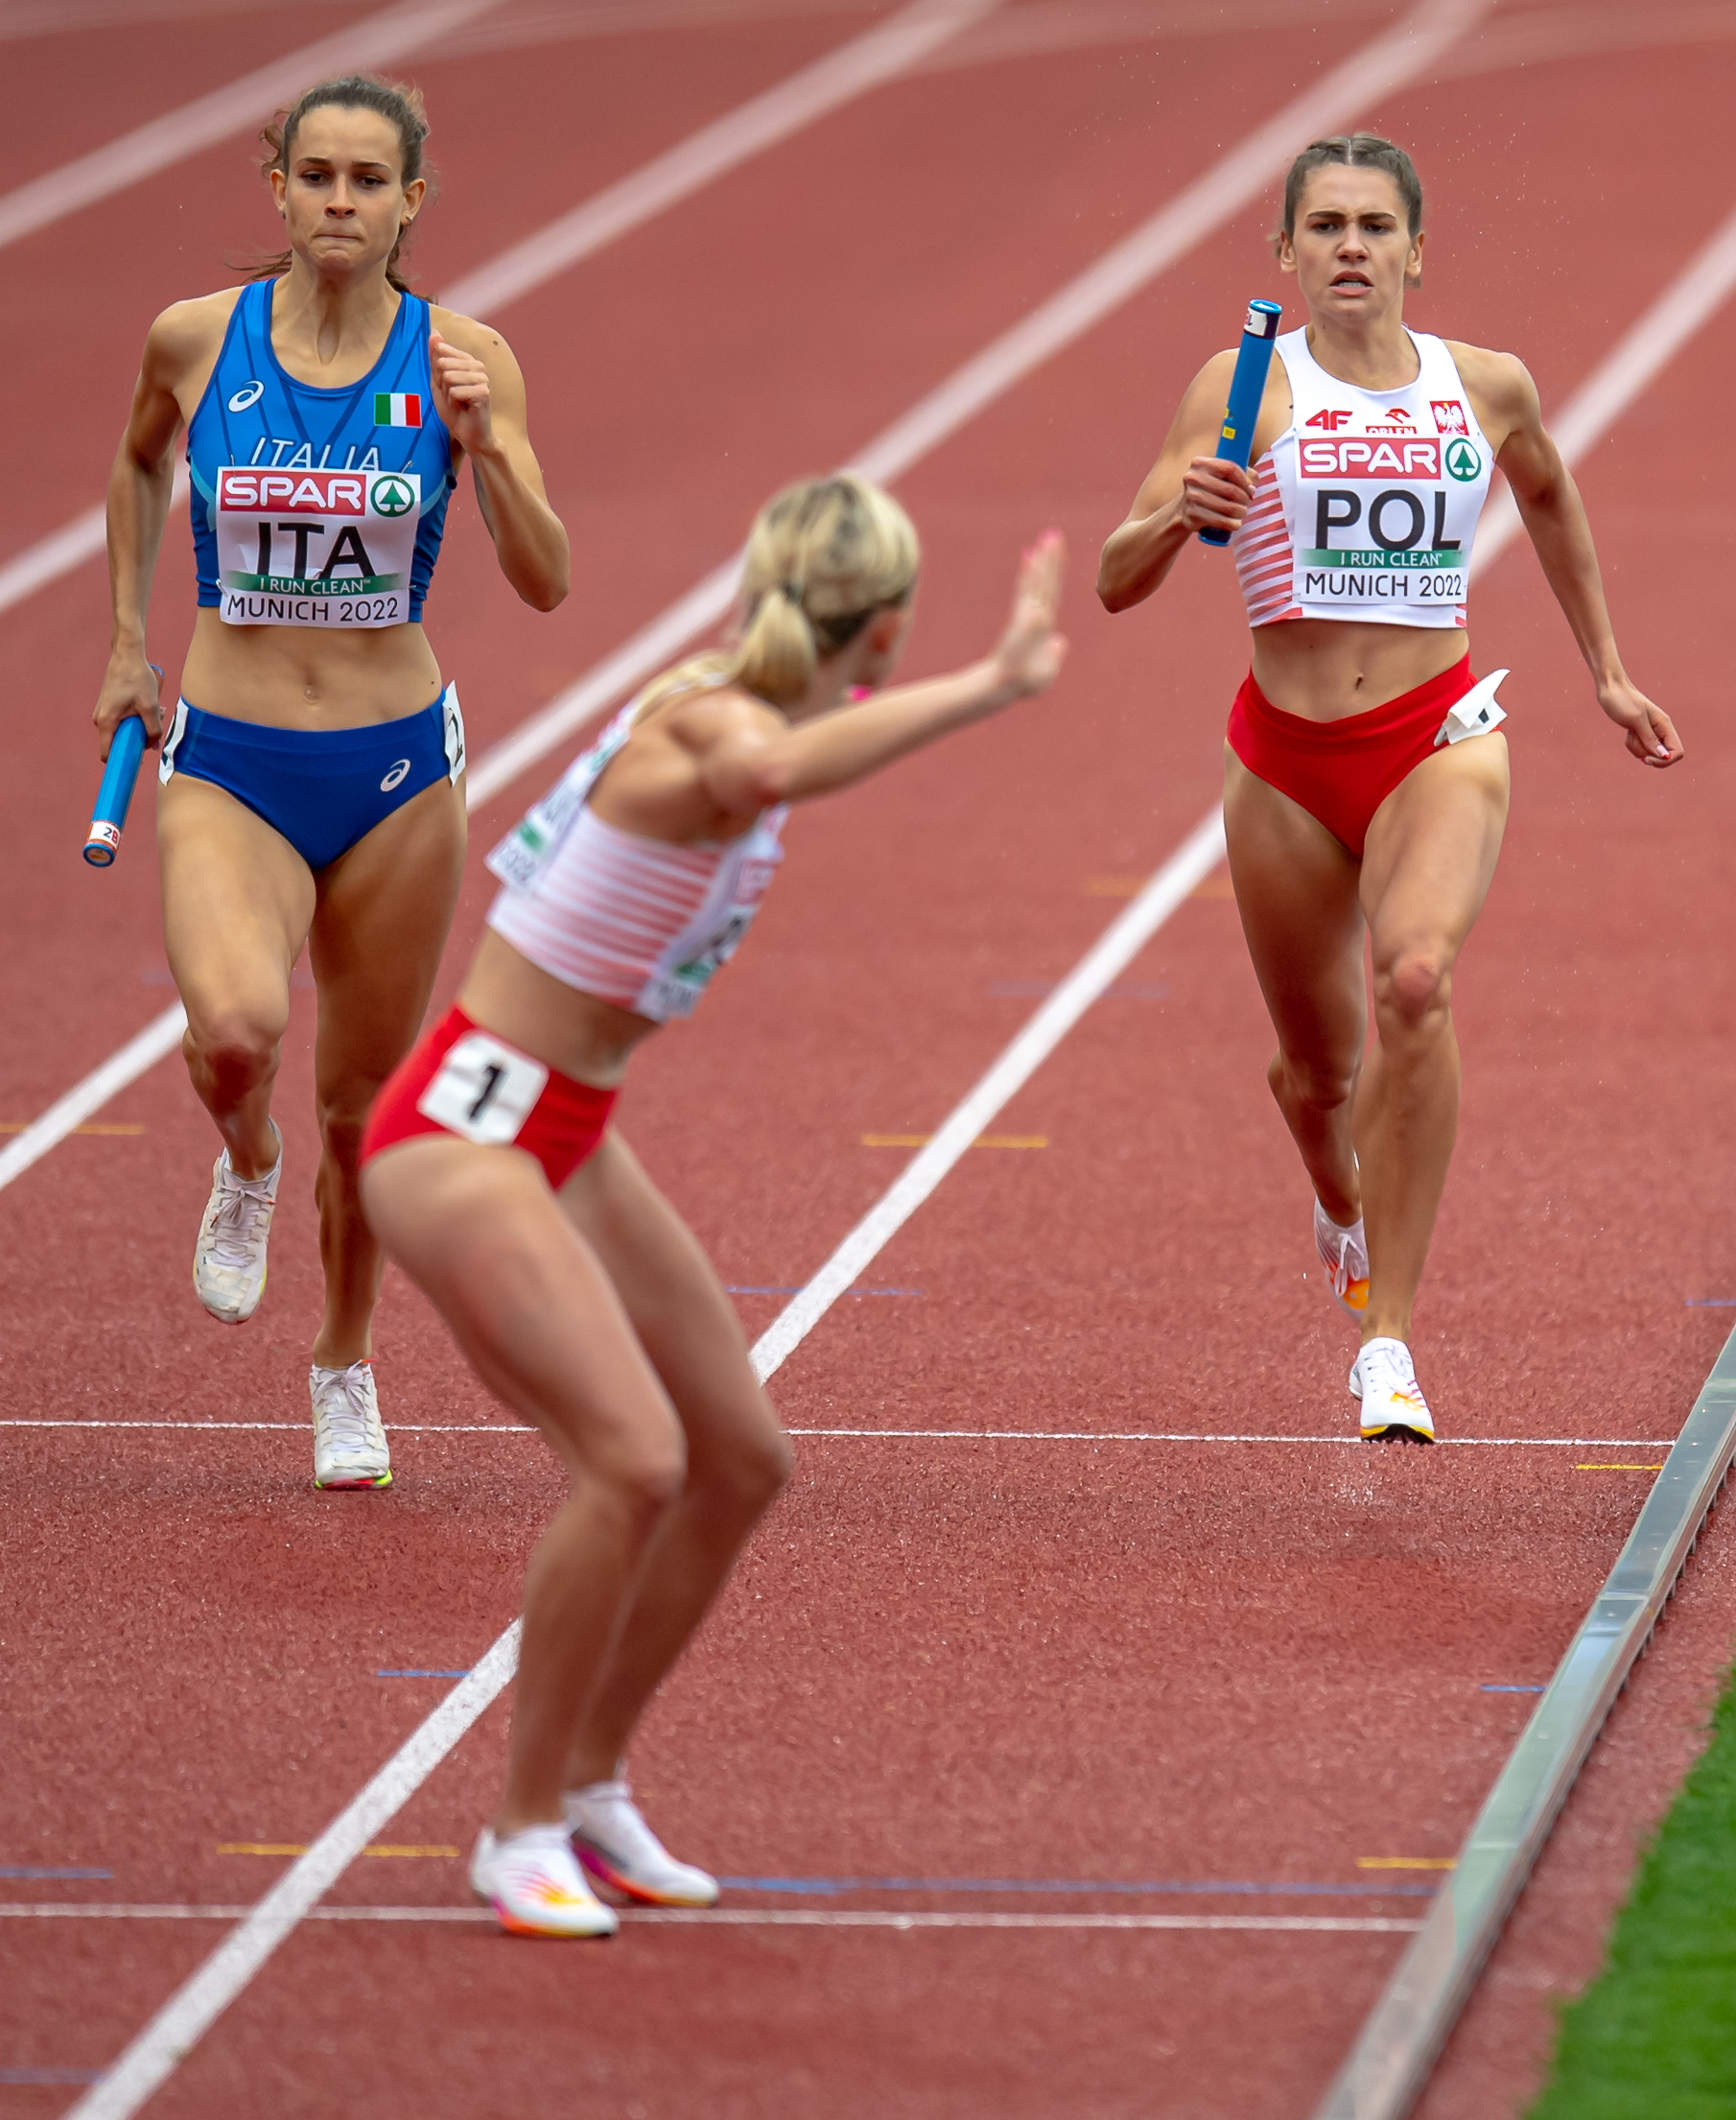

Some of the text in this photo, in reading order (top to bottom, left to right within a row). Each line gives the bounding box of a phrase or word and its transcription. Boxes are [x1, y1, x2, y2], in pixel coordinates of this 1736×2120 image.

[1305, 409, 1352, 431] 4F
[250, 436, 380, 471] ITALIA
[1302, 442, 1438, 474] SPAR
[223, 476, 363, 509] SPAR
[1315, 489, 1462, 551] POL
[256, 521, 377, 579] ITA
[1340, 553, 1346, 566] I
[1350, 553, 1385, 566] RUN
[260, 577, 265, 591] I
[270, 578, 305, 594] RUN
[1305, 573, 1462, 597] MUNICH 2022
[227, 594, 399, 623] MUNICH 2022
[466, 1059, 506, 1124] 1
